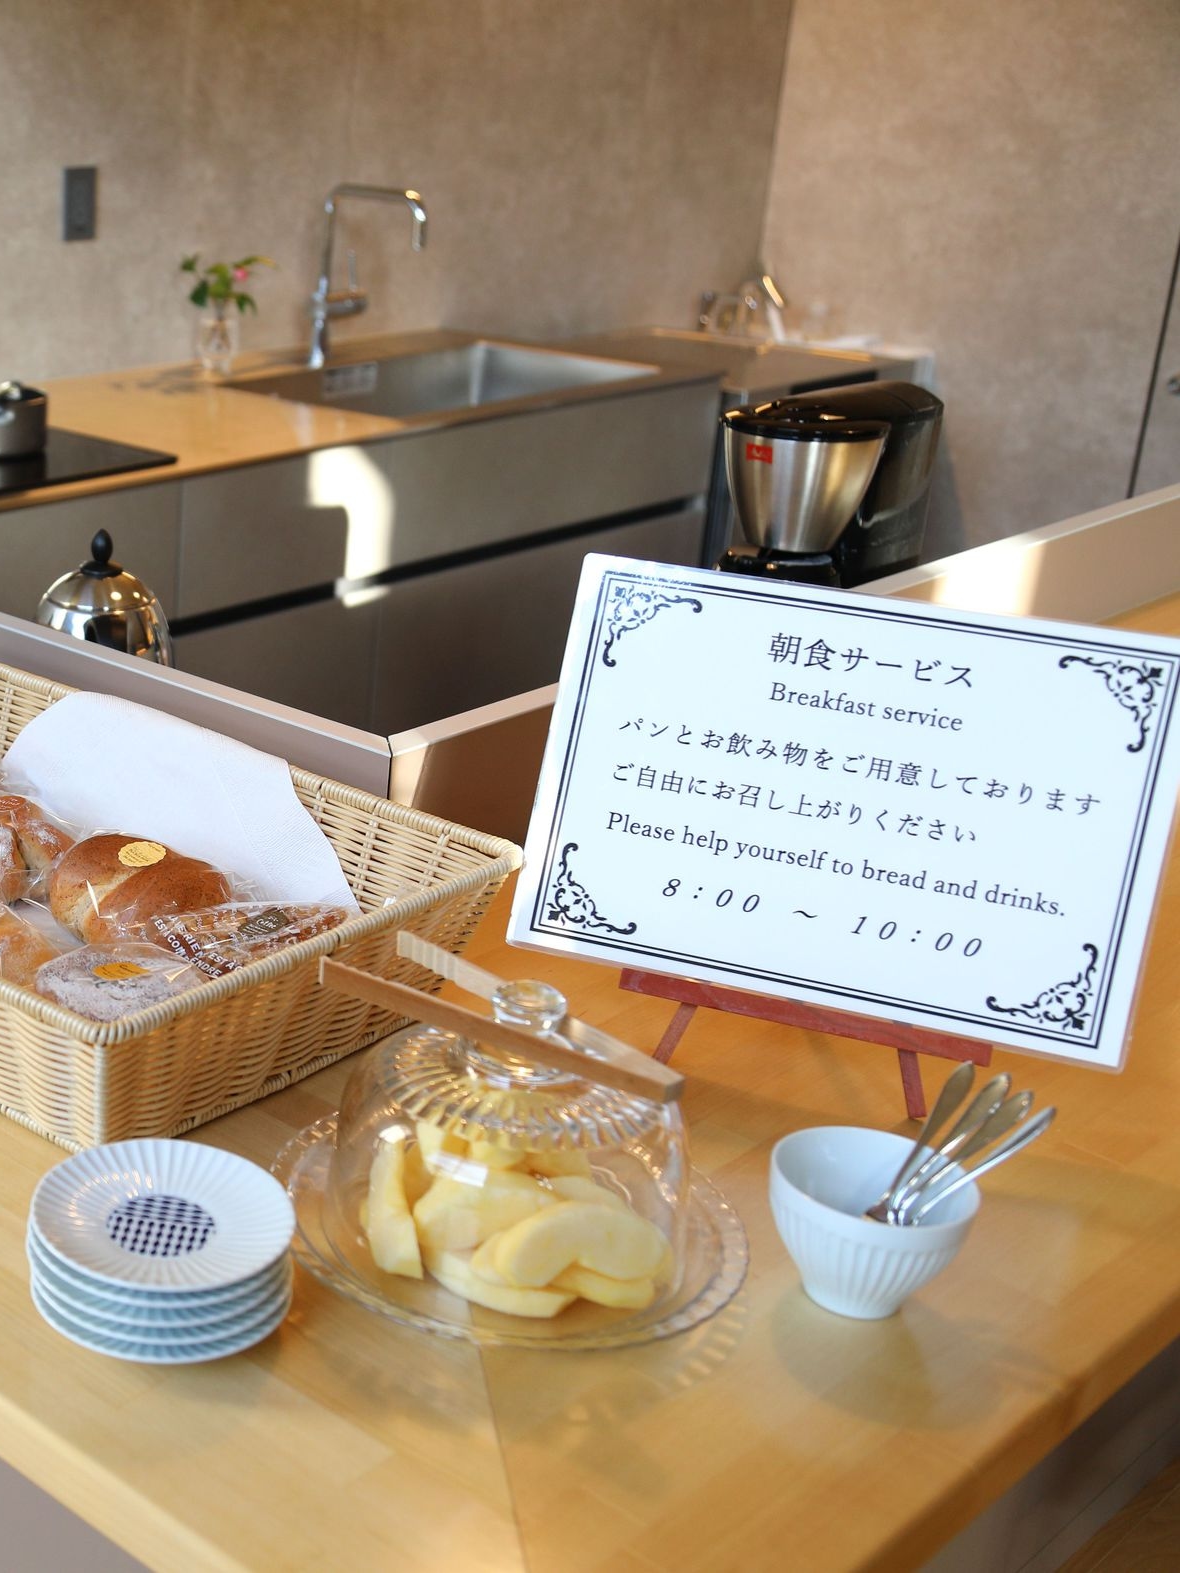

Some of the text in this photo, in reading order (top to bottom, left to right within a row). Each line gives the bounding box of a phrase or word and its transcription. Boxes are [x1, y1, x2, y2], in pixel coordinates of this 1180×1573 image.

[767, 632, 973, 688] 朝食サービス
[769, 681, 963, 731] Breakfast service
[613, 763, 976, 842] ご自由にお召し上がりください
[619, 718, 1101, 815] パンとお飲み物をご用意しております
[606, 811, 1066, 917] Please help yourself to bread and drinks.
